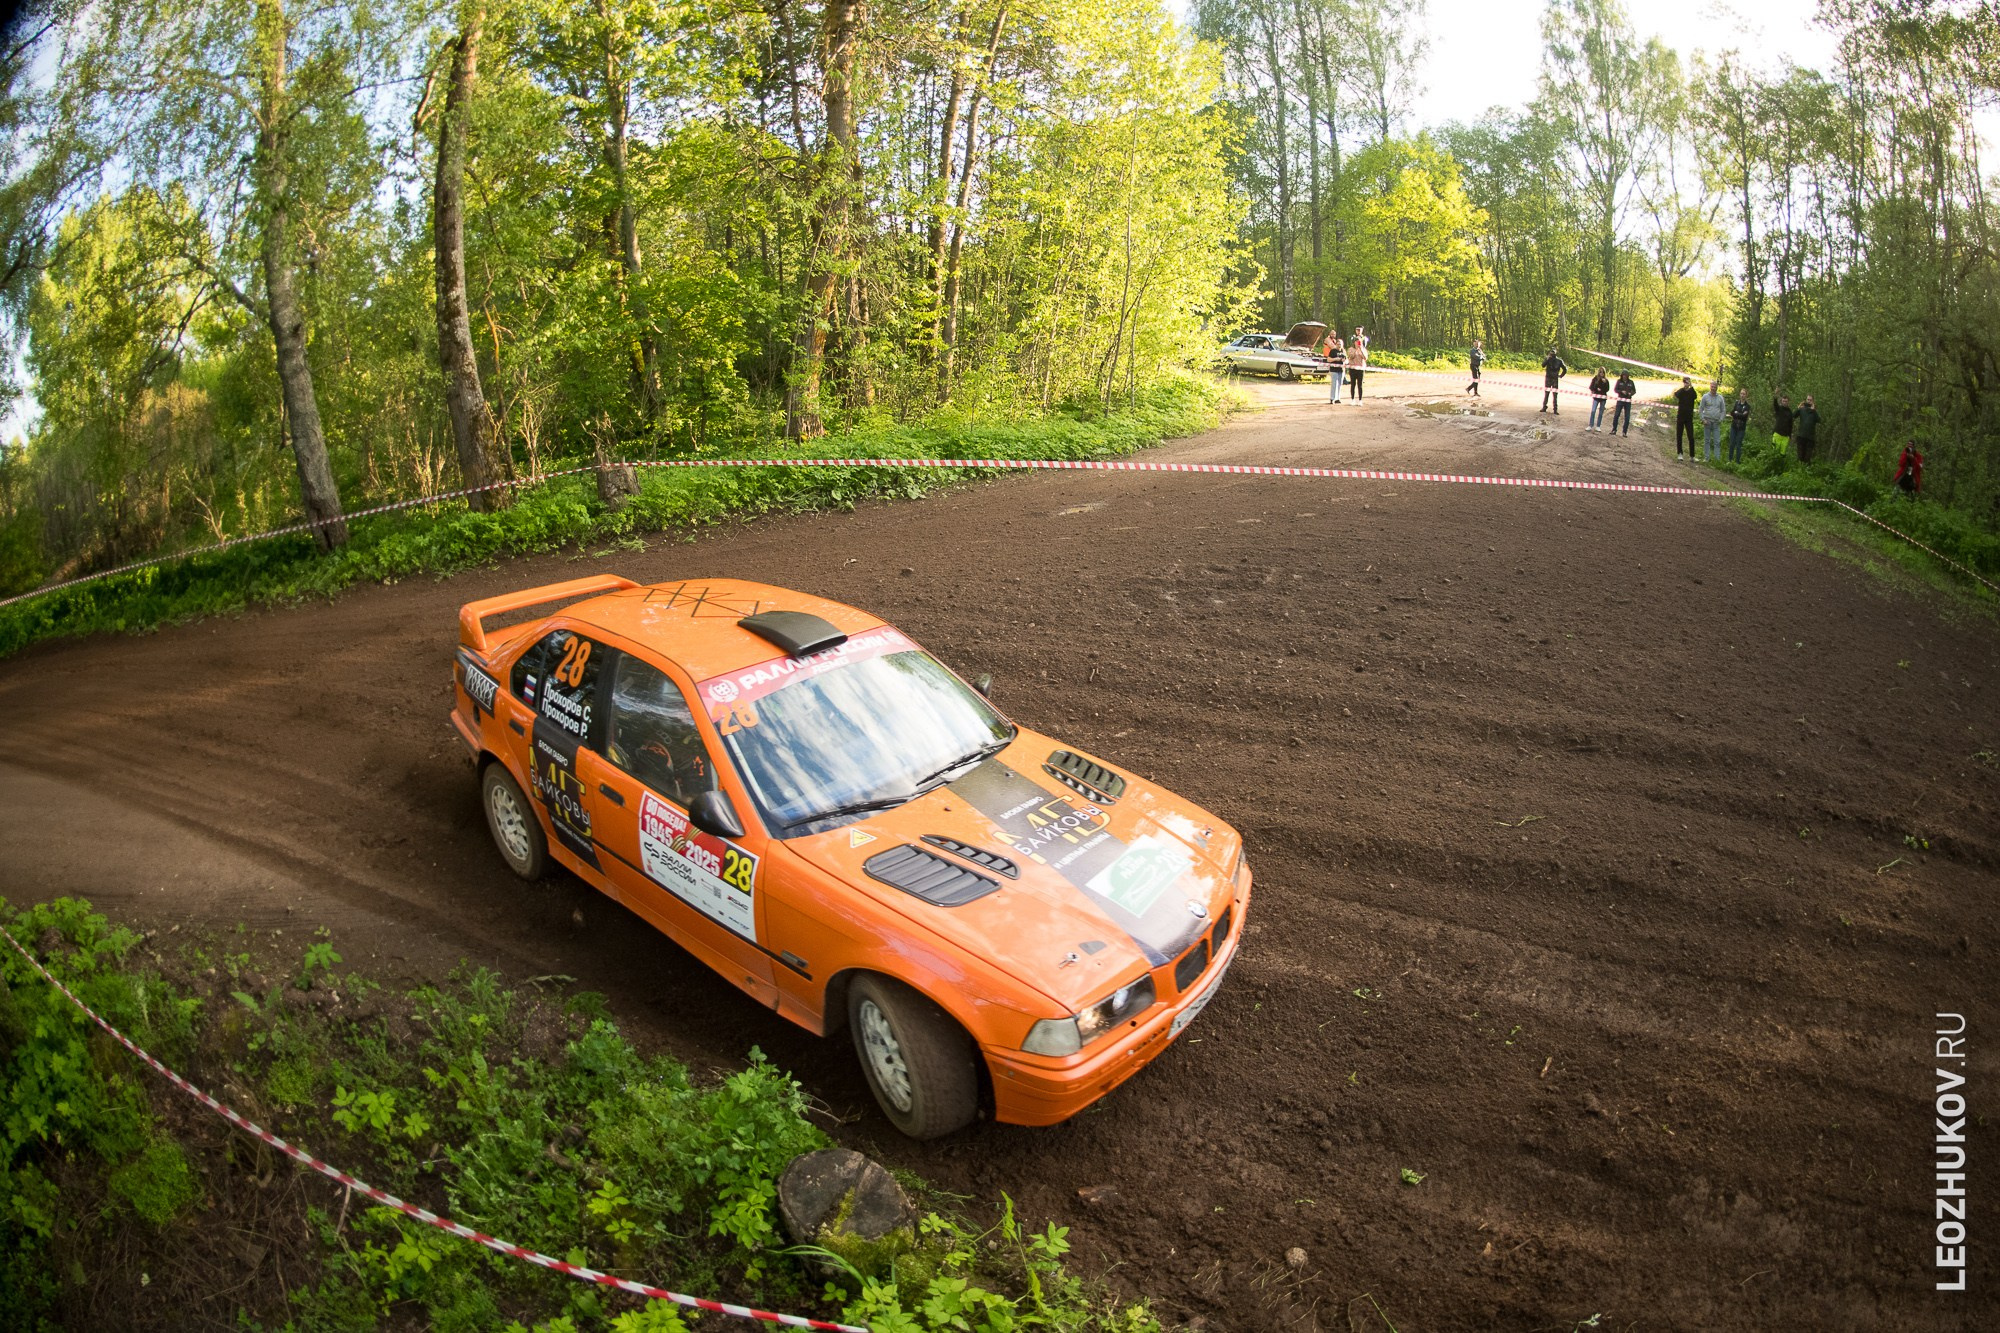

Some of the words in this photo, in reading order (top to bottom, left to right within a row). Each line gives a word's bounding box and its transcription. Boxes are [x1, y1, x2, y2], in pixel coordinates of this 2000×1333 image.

[555, 635, 591, 688] 28
[541, 698, 580, 734] Прохоров
[580, 722, 589, 739] Р.
[544, 682, 582, 717] Прохоров
[583, 705, 592, 723] С.
[711, 700, 760, 737] 28
[530, 768, 591, 828] БАЙКОВЫ
[645, 798, 659, 815] 80
[644, 814, 674, 848] 1945
[685, 840, 721, 877] 2025
[1013, 804, 1103, 857] БАЙКОВЫ
[722, 849, 753, 893] 28
[1155, 848, 1189, 873] 28
